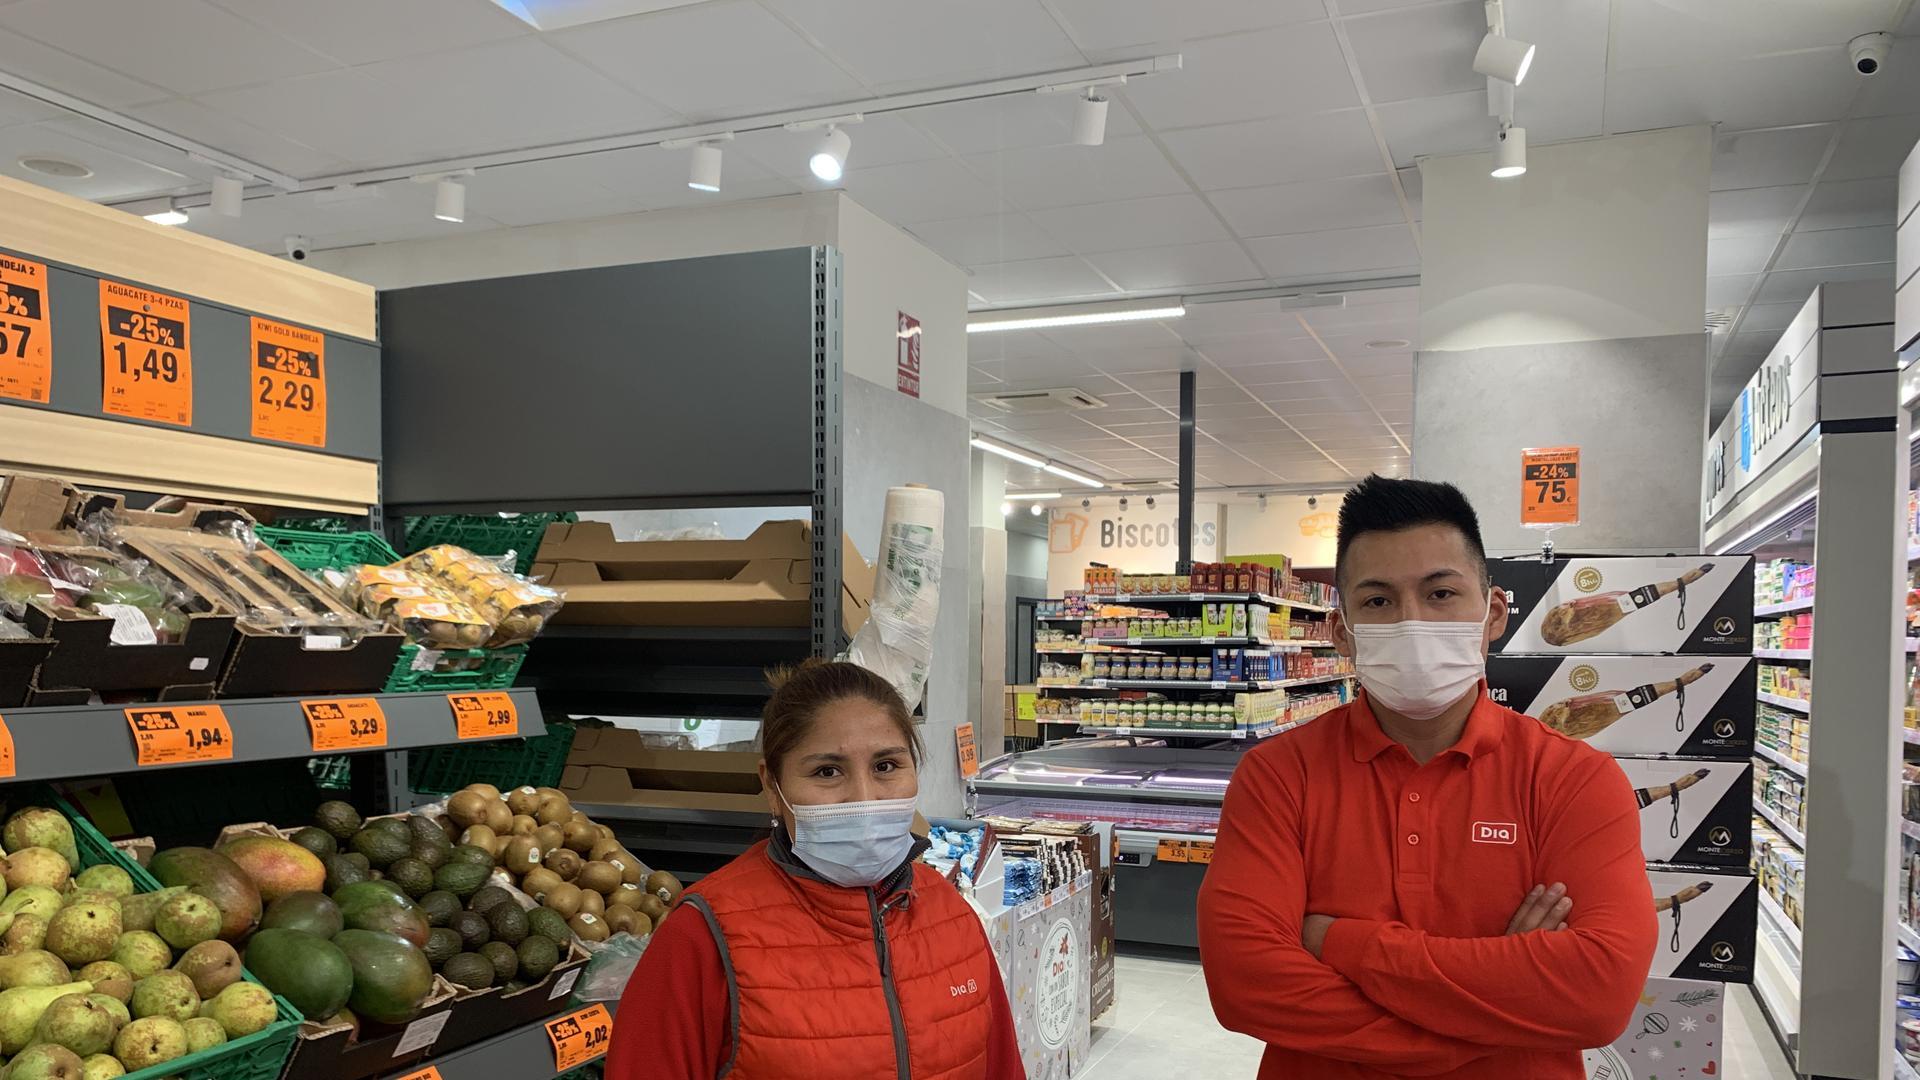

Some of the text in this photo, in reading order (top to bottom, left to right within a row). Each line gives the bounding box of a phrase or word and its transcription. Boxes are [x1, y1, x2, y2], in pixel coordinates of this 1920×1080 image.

[107, 284, 148, 302] AGUACATE
[120, 313, 175, 346] -25%
[257, 322, 272, 333] KIWI
[273, 326, 290, 338] GOLD
[113, 341, 178, 383] 1,49
[266, 347, 312, 377] -25%
[259, 375, 314, 411] 2,29
[1533, 464, 1569, 479] -24%
[1535, 480, 1566, 503] 75
[137, 713, 176, 729] -25%
[349, 718, 378, 738] 3,29
[487, 710, 510, 727] 2,99
[185, 727, 223, 751] 1,94
[585, 1025, 608, 1048] 2,02
